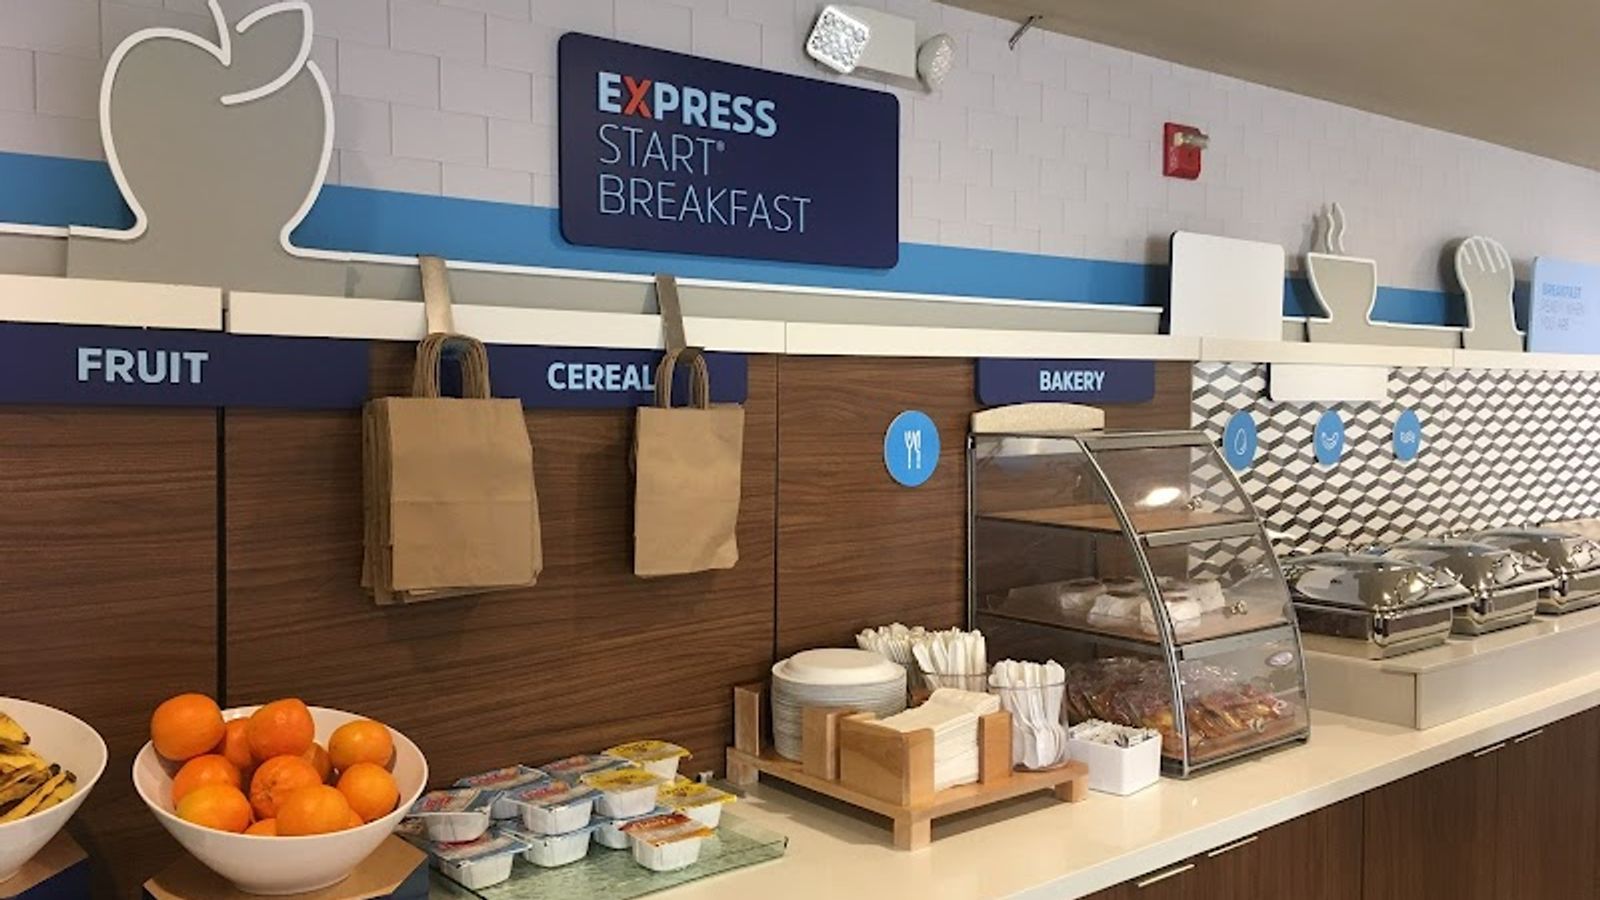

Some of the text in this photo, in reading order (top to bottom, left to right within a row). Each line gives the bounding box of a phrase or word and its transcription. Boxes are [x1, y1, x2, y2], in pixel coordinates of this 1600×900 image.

[597, 71, 778, 137] EXPRESS
[599, 173, 812, 233] BREAKFAST
[77, 347, 209, 384] FRUIT
[547, 362, 656, 391] CEREAL
[1039, 370, 1106, 392] BAKERY
